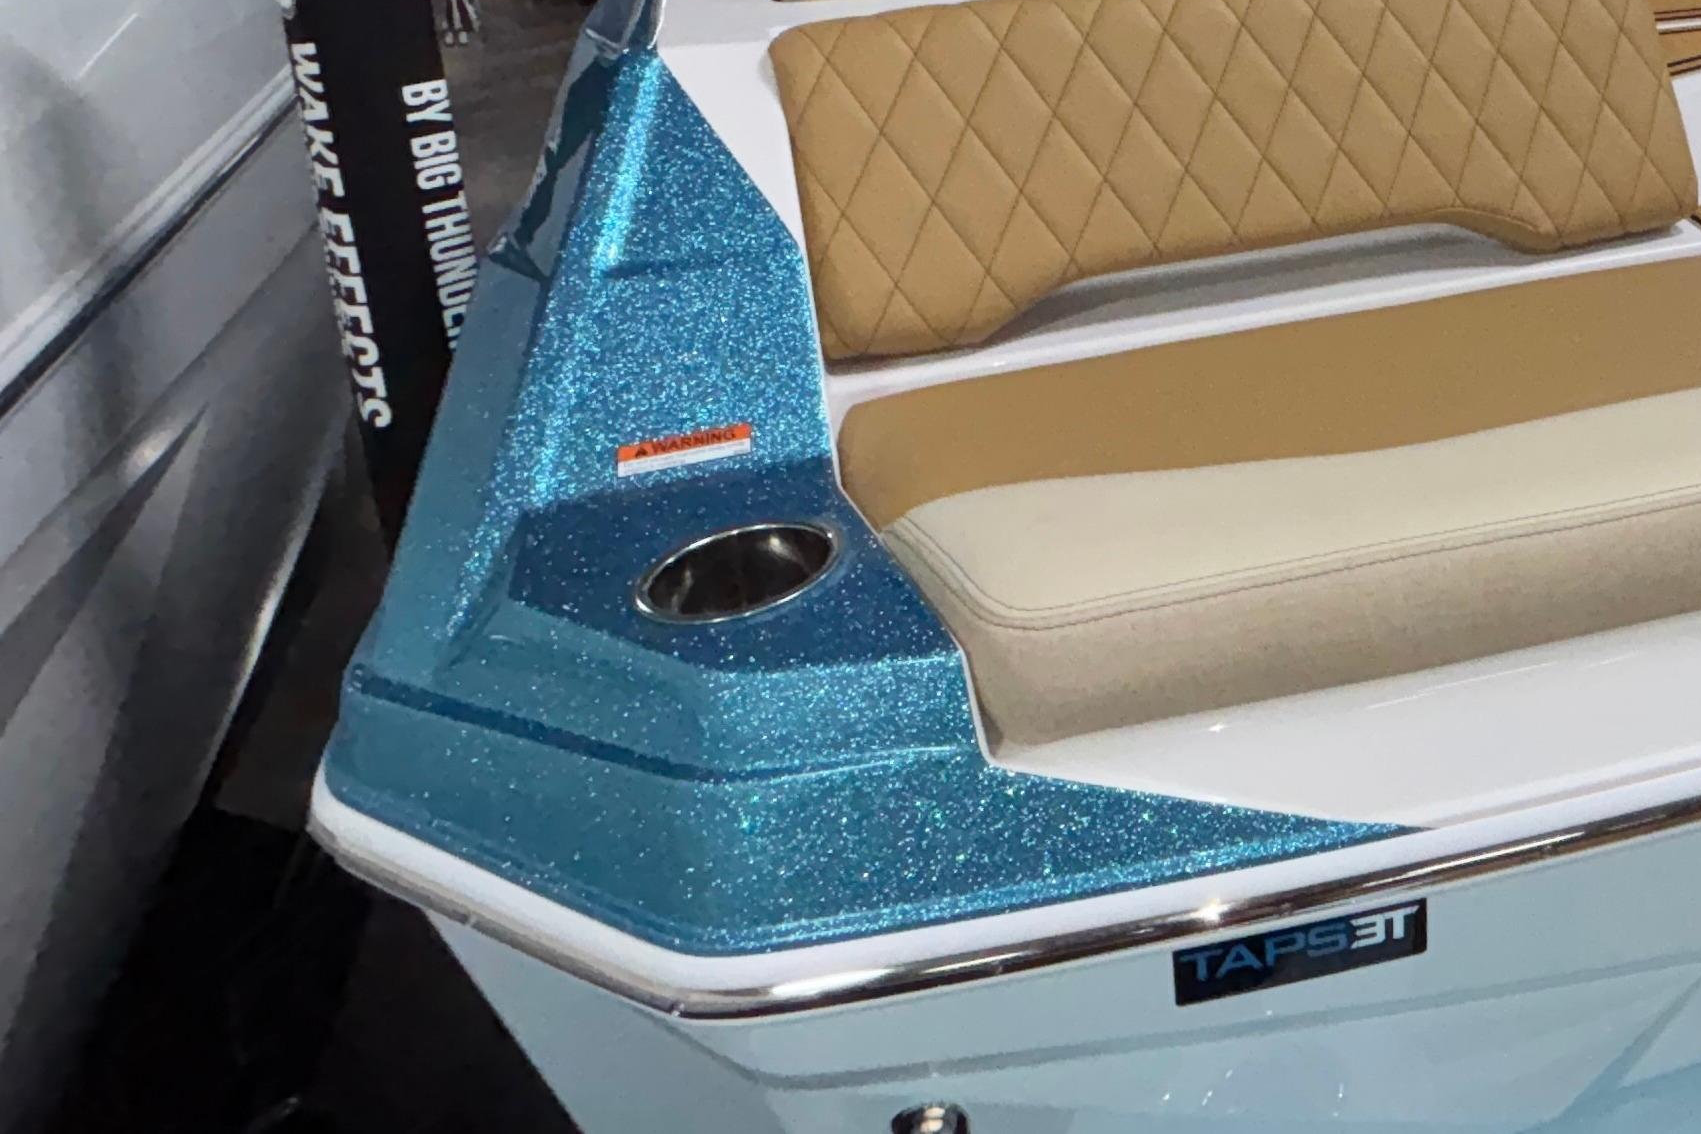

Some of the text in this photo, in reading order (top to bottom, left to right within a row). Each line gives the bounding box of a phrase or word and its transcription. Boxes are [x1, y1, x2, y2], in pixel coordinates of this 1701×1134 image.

[402, 79, 453, 123] BY
[410, 130, 463, 191] BIG
[652, 429, 736, 454] WARNING
